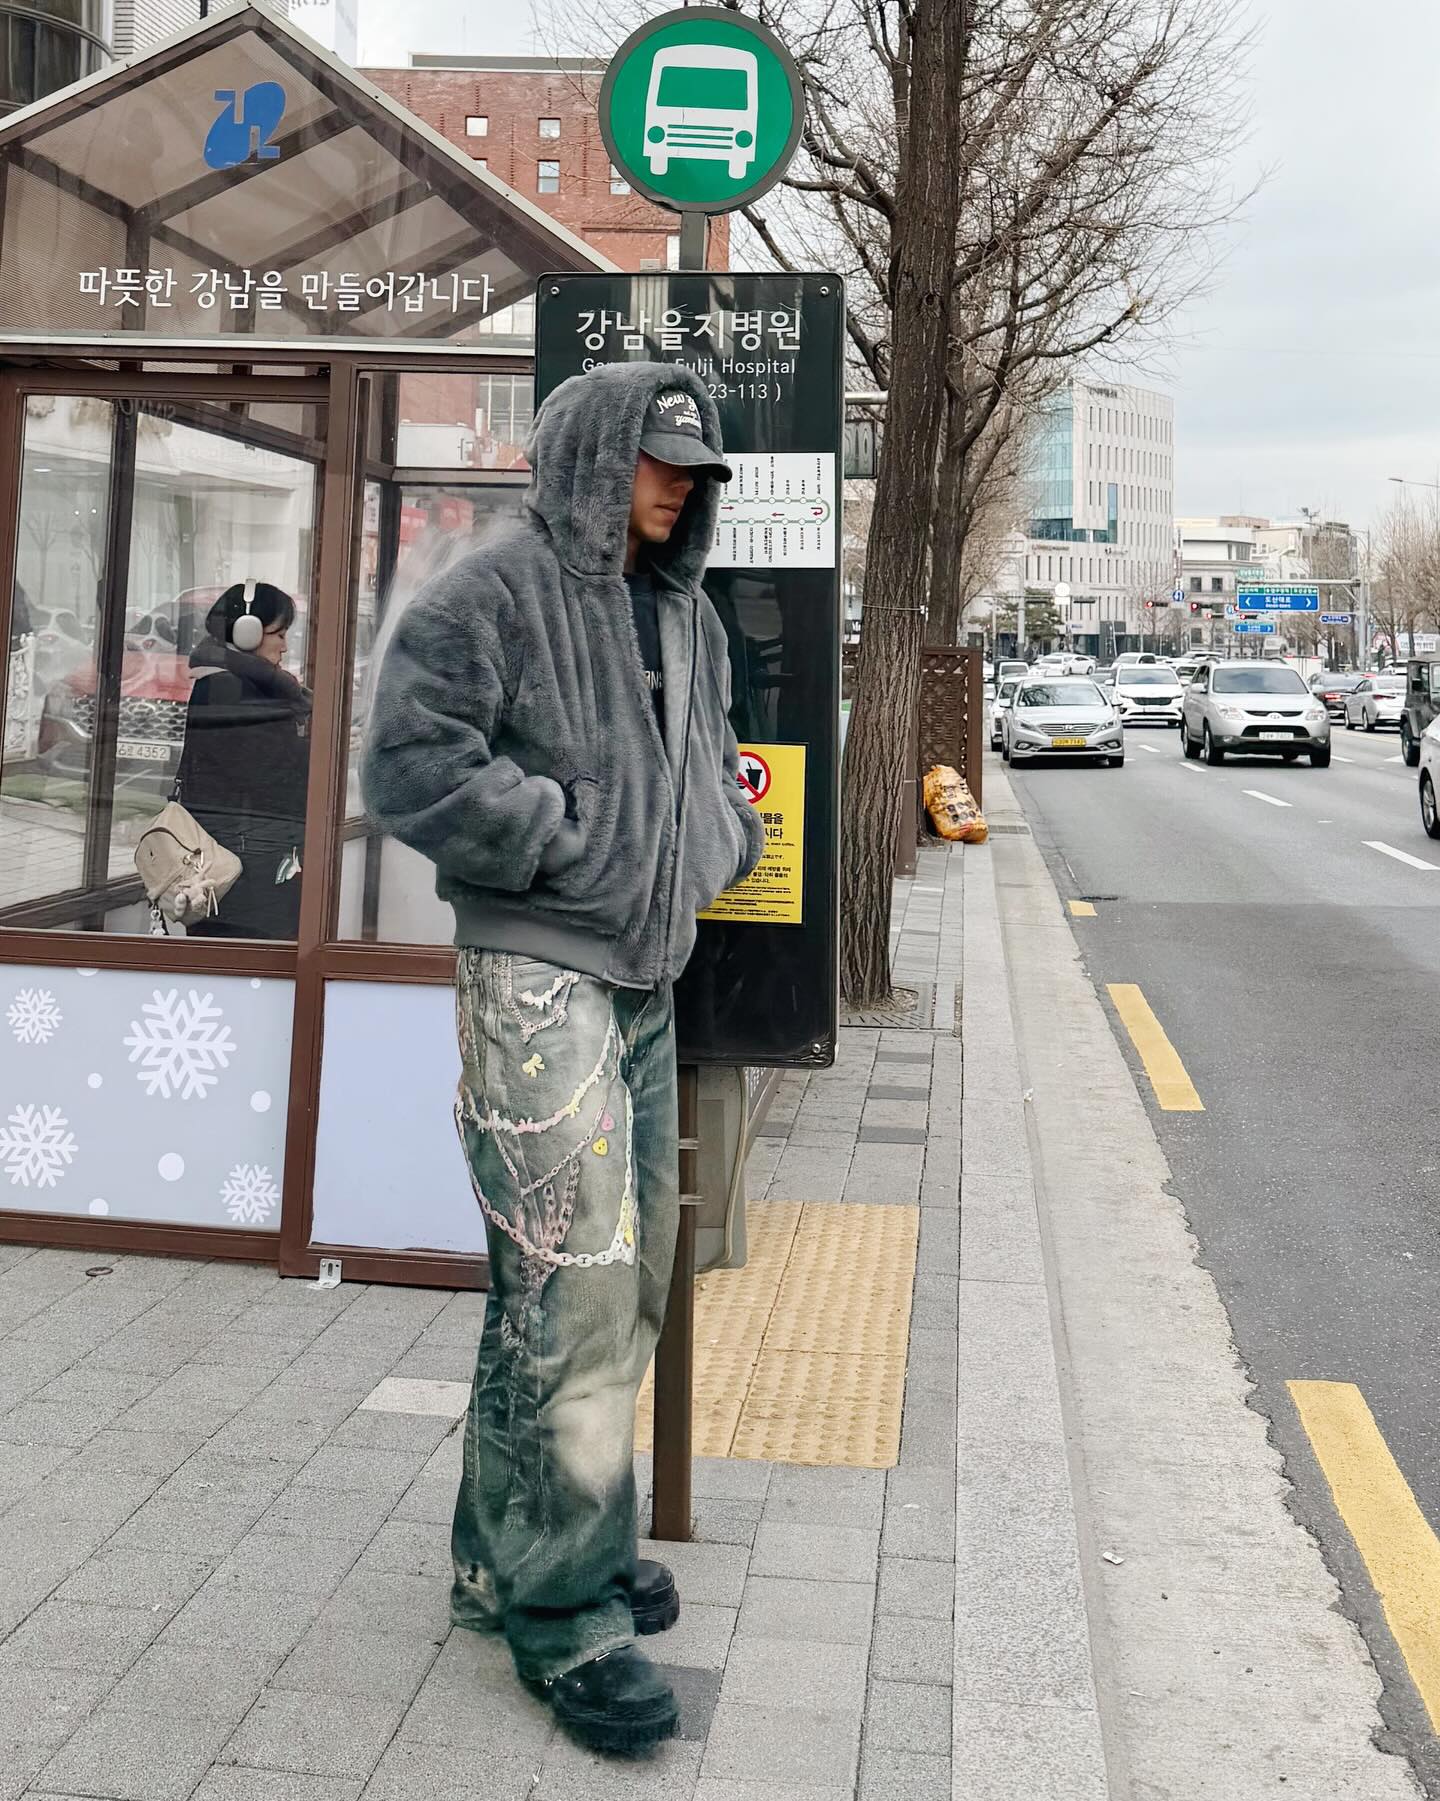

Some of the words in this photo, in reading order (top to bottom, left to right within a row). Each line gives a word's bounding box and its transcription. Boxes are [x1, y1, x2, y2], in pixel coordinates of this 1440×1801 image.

[79, 266, 178, 307] 따뜻한
[189, 269, 288, 310] 강남을
[300, 271, 495, 314] 만들어갑니다
[576, 309, 801, 351] 강남을지병원
[722, 357, 796, 377] Hospital
[707, 383, 768, 399] 23-113
[656, 393, 685, 414] New
[137, 745, 167, 759] 4352
